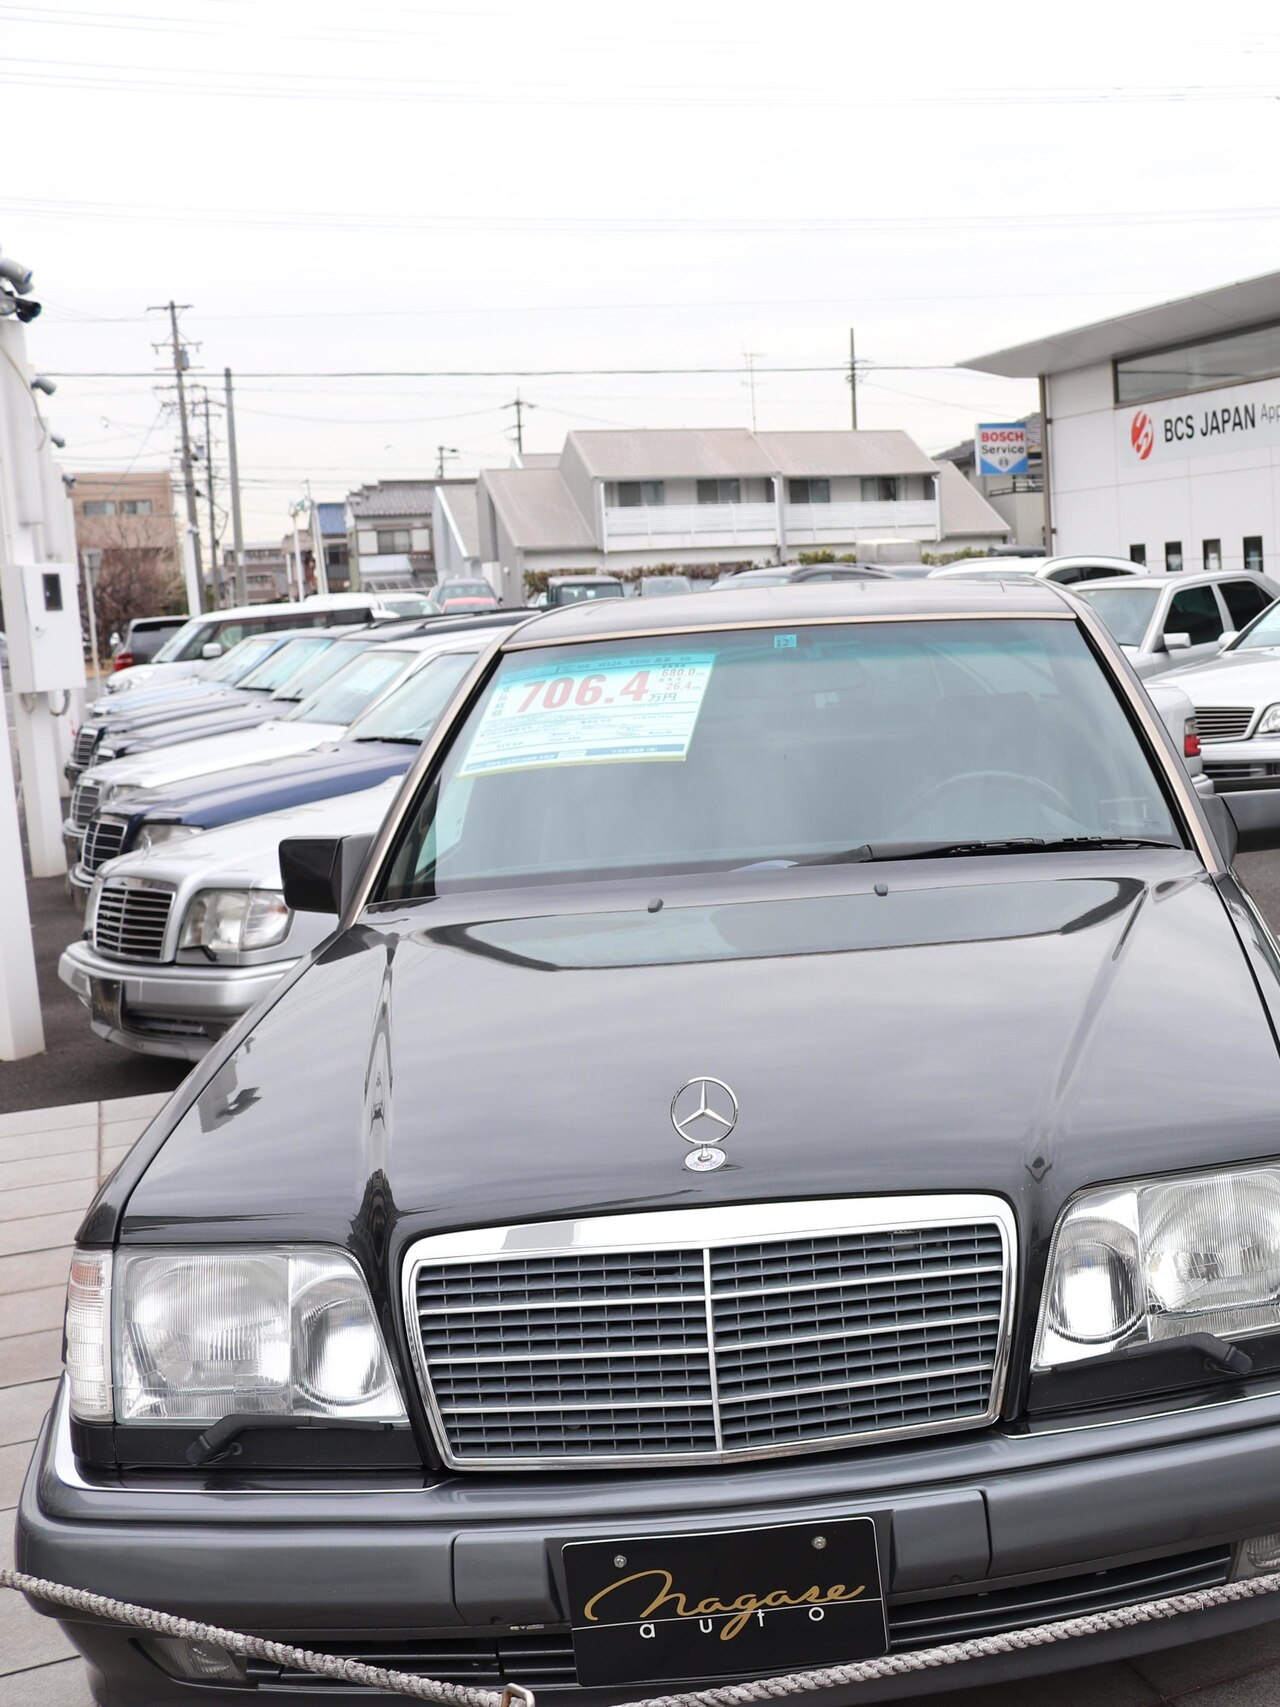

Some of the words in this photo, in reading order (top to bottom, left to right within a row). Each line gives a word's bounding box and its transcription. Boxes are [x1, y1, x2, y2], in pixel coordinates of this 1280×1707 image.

[1163, 414, 1195, 443] BCS
[1200, 403, 1256, 437] JAPAN
[981, 431, 1024, 442] BOSCH
[981, 443, 1025, 454] Service
[662, 667, 696, 678] 680.0
[516, 670, 651, 713] 706.4
[665, 681, 692, 691] 26.4
[648, 692, 678, 703] 万円
[584, 1569, 866, 1641] Nagase
[639, 1606, 825, 1639] auto
